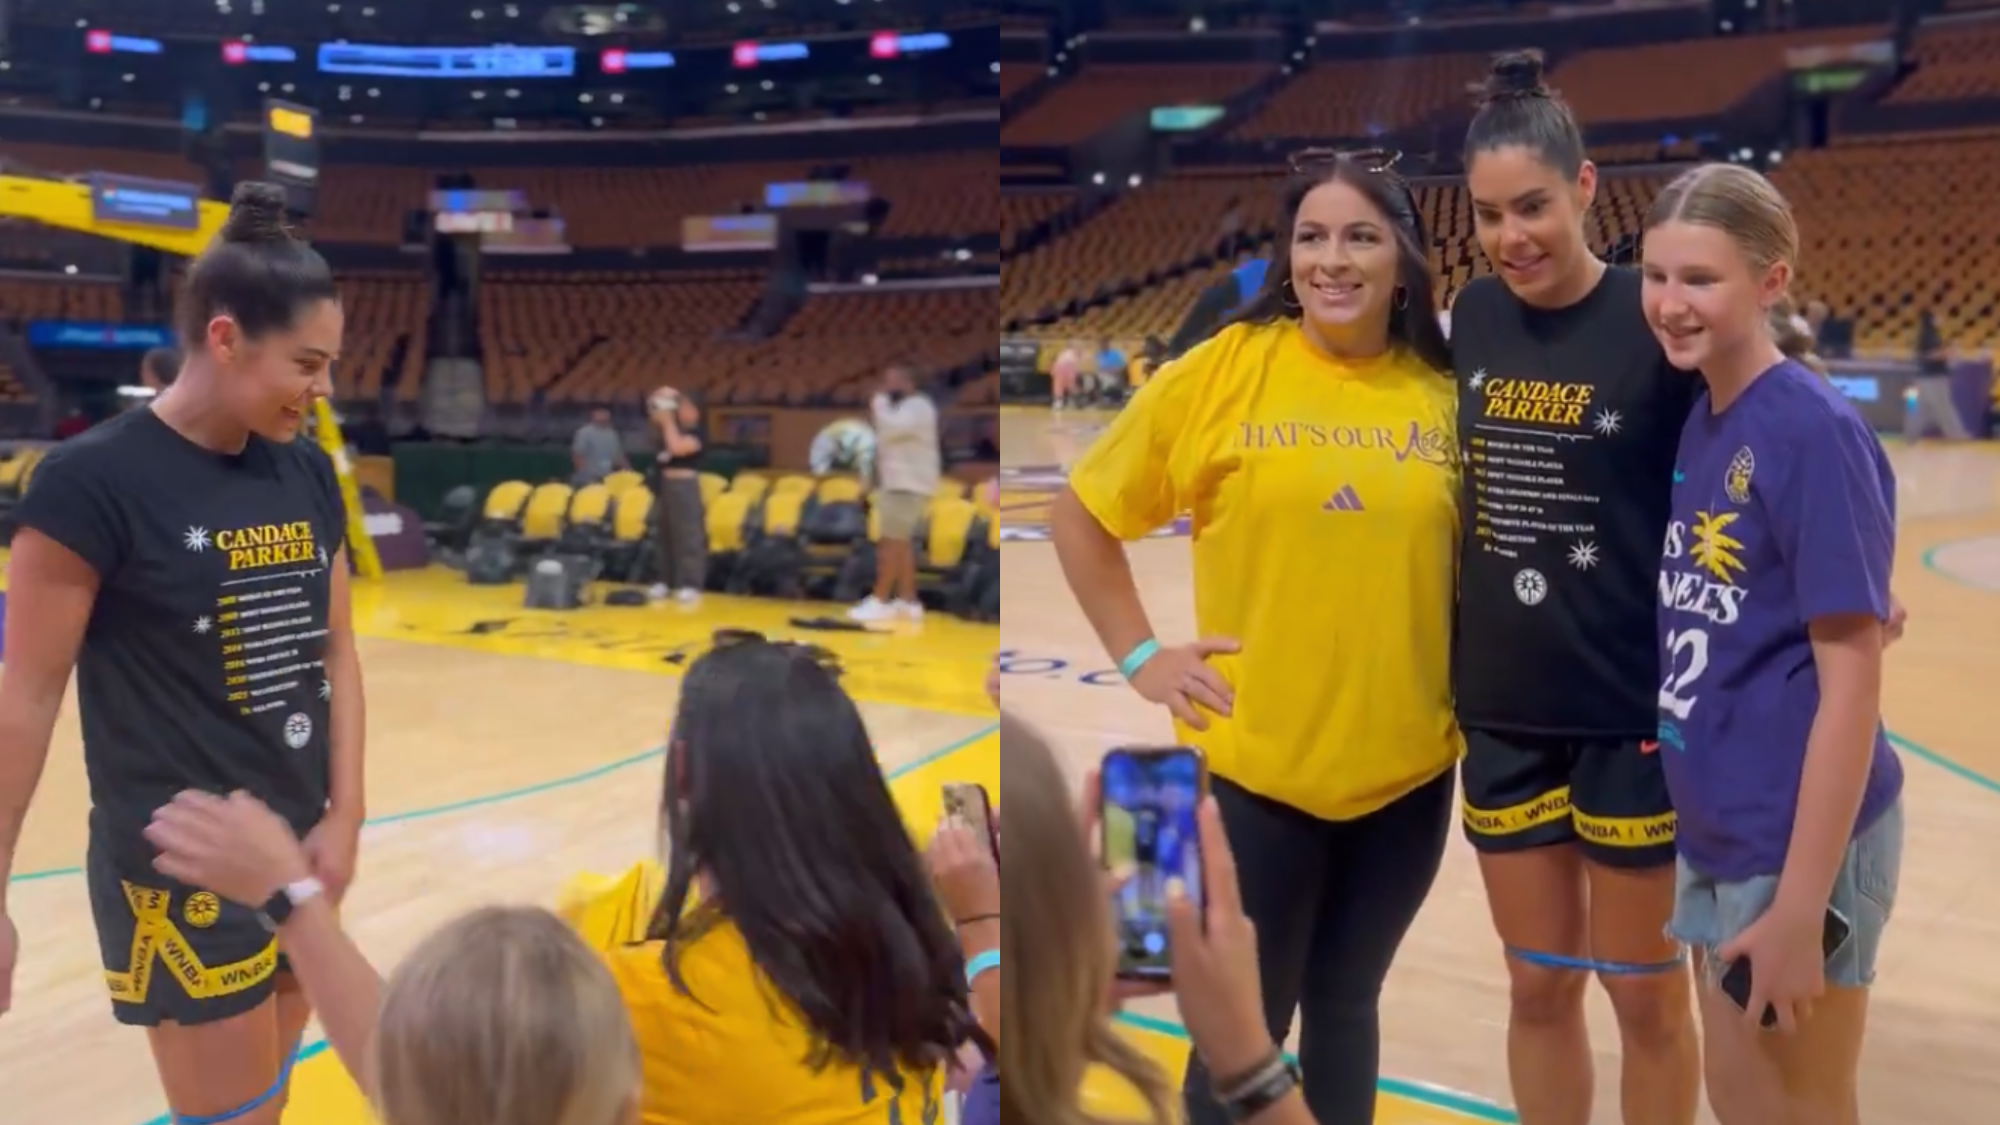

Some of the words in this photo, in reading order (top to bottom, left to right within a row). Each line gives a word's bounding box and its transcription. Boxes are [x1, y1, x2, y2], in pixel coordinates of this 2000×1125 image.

[1485, 378, 1595, 404] CANDACE
[1484, 398, 1584, 425] PARKER
[1332, 426, 1396, 450] OUR
[215, 521, 314, 550] CANDACE
[229, 541, 315, 570] PARKER
